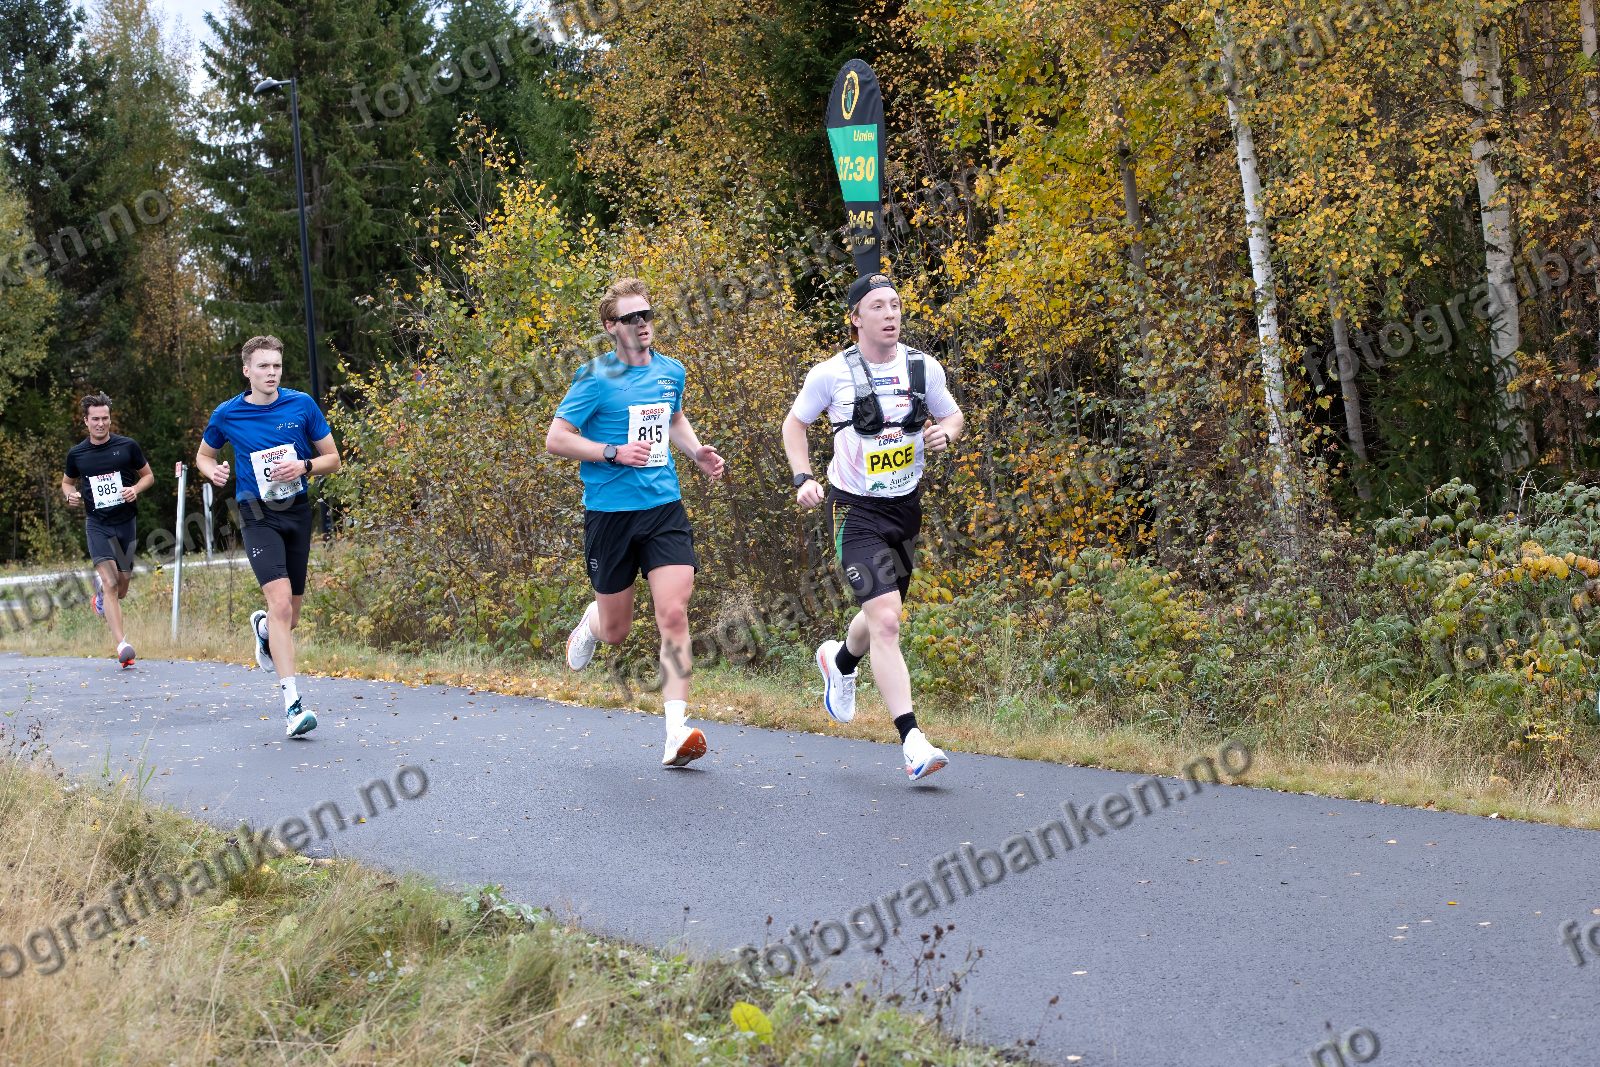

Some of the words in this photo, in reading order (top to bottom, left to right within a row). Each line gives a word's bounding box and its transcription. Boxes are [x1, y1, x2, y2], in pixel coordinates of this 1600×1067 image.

[848, 209, 874, 229] 3:45
[638, 424, 663, 444] 815
[870, 446, 913, 472] PACE
[97, 483, 118, 497] 985
